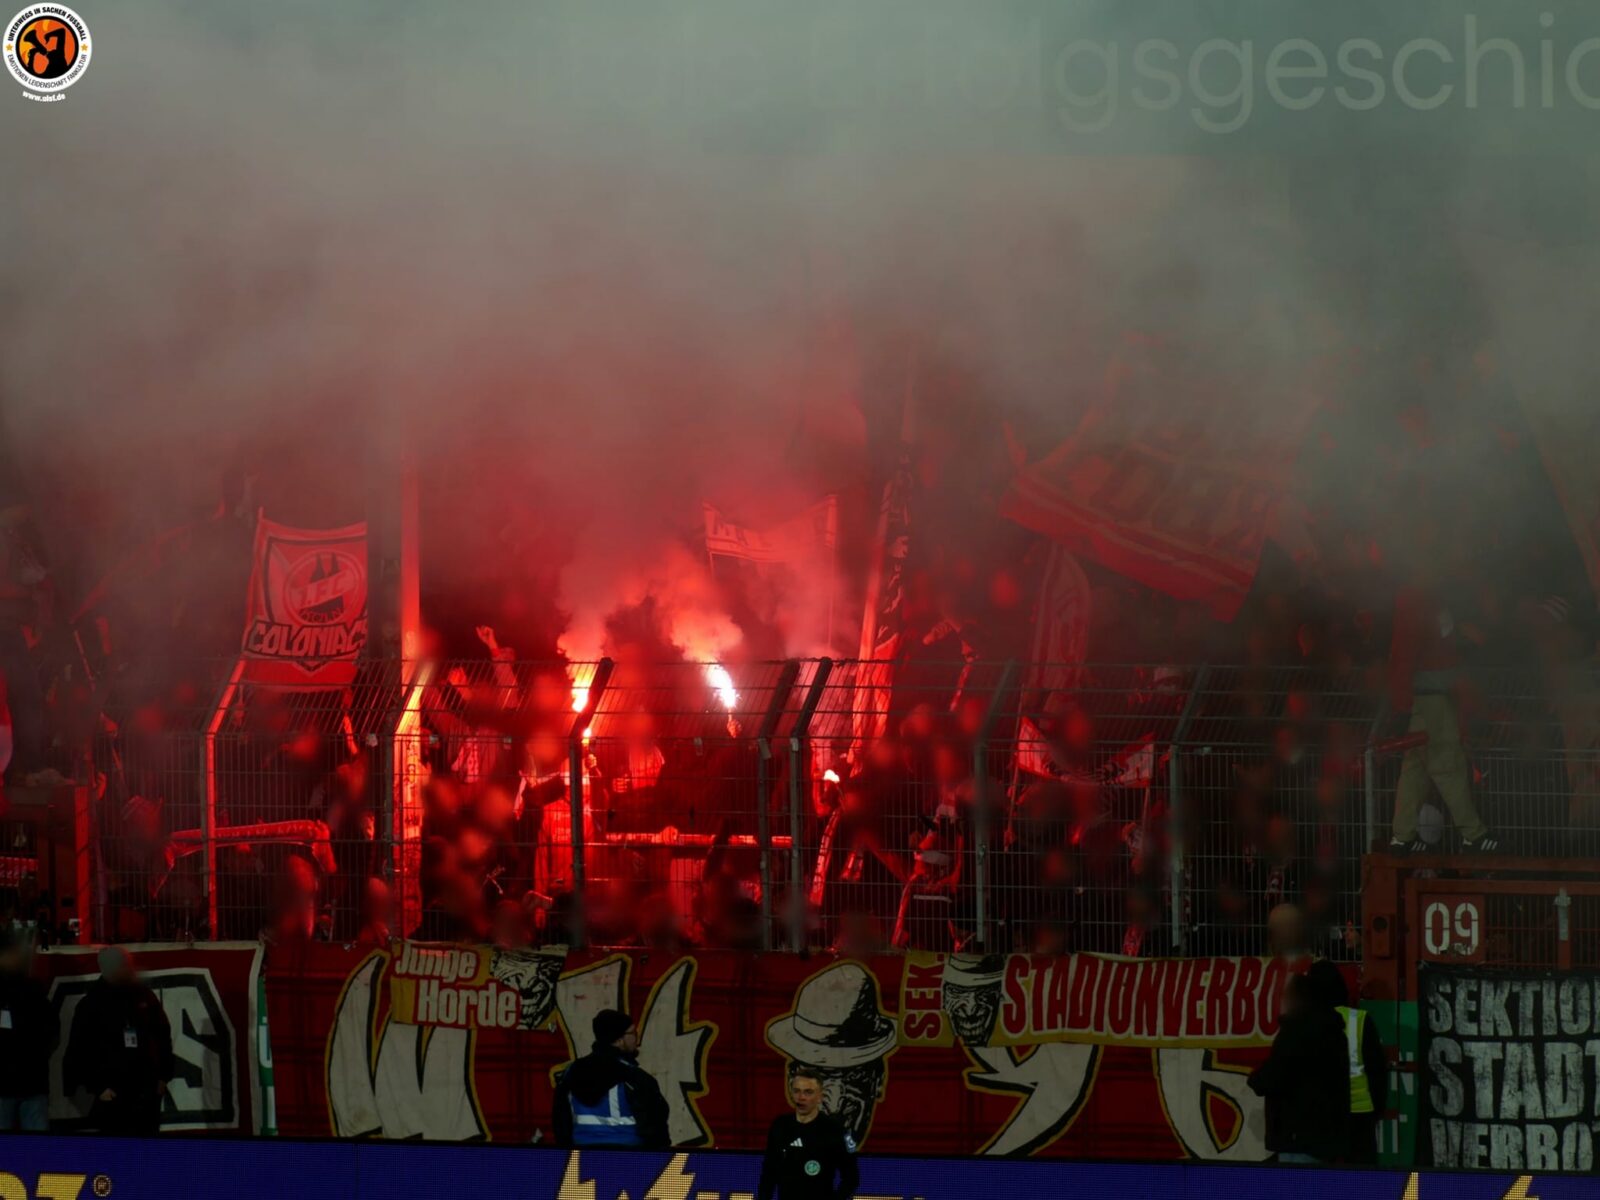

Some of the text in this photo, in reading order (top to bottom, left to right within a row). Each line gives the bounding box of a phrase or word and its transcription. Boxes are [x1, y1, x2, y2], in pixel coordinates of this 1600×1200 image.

[249, 619, 368, 657] COLONIAC
[1424, 902, 1479, 956] 09
[395, 942, 477, 983] Junge
[417, 978, 517, 1030] Horde
[904, 952, 945, 1039] SEK.
[1003, 952, 1296, 1036] STADIONVERBO
[1426, 975, 1600, 1034] SEKTIO
[1429, 1117, 1600, 1171] VERBO
